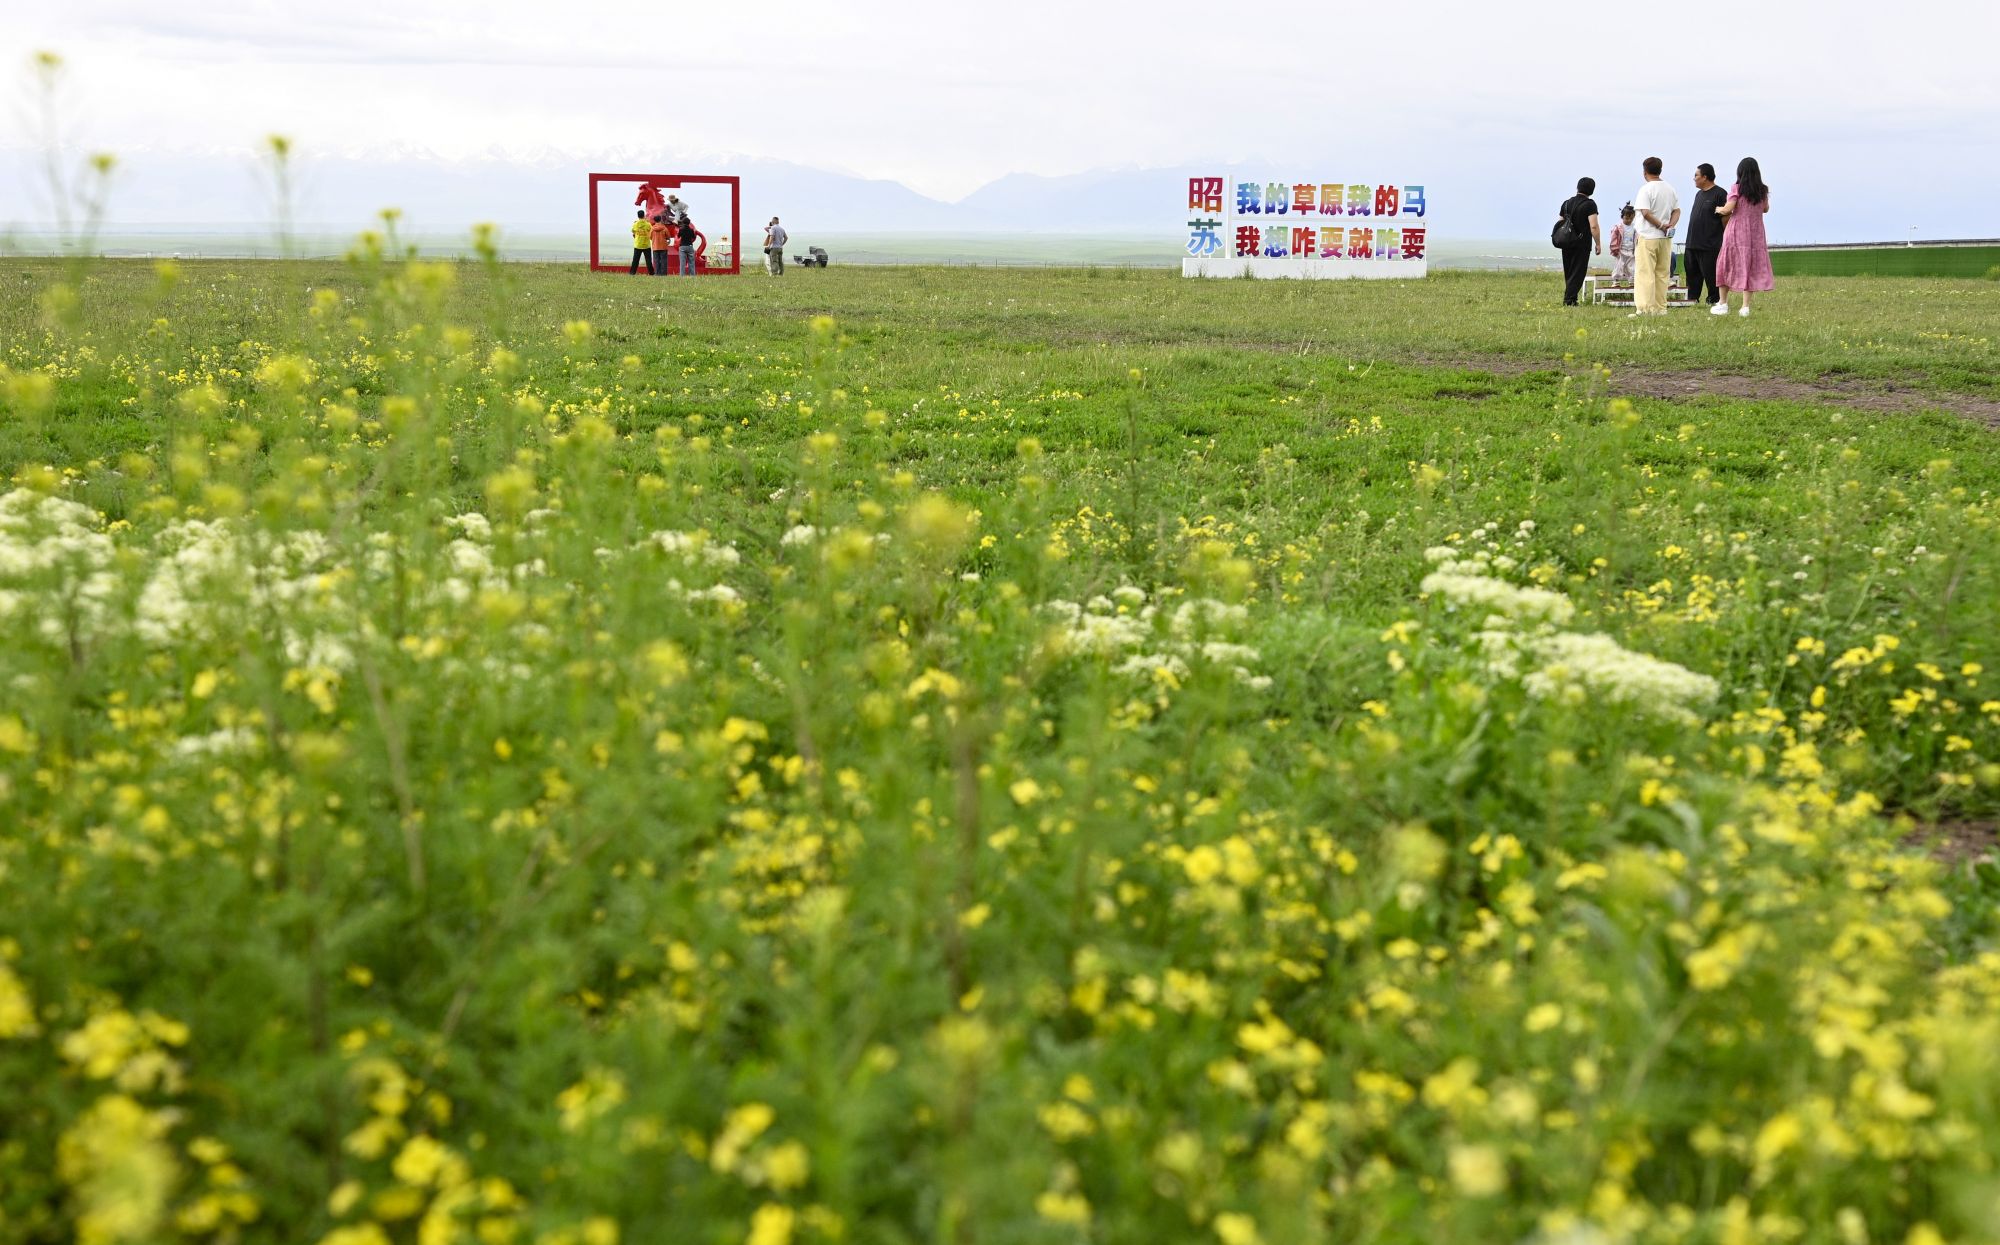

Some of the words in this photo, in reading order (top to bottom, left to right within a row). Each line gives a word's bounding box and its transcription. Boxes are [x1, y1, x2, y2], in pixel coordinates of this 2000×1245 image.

[1187, 177, 1224, 255] 昭苏
[1236, 182, 1426, 217] 我的草原我的马
[1235, 225, 1426, 260] 我想咋耍就咋耍
